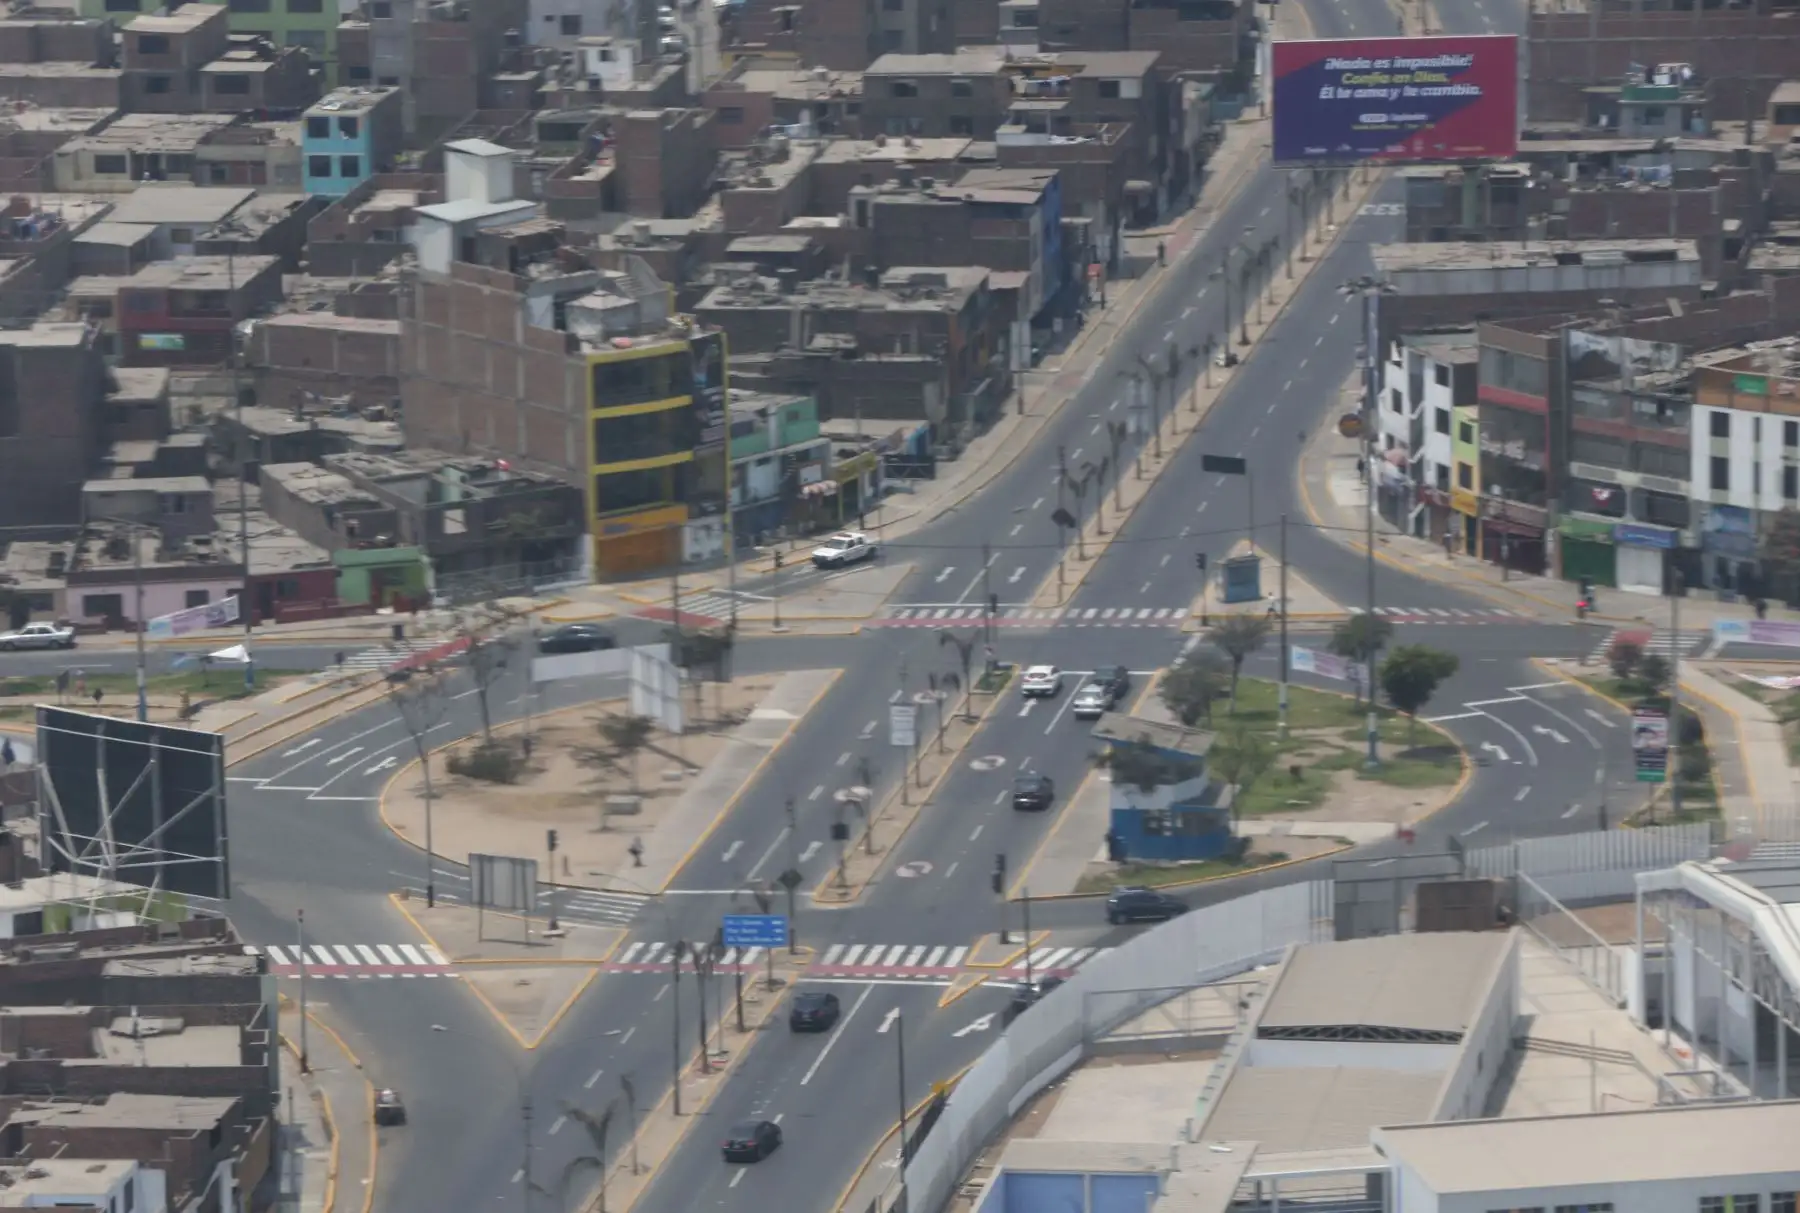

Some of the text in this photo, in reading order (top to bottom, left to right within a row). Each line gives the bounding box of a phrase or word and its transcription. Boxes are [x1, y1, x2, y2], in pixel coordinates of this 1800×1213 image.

[1373, 59, 1390, 69] es
[1391, 74, 1411, 84] en
[1336, 87, 1351, 98] te
[1353, 88, 1388, 98] ama
[1388, 88, 1400, 101] y
[1403, 85, 1418, 97] te
